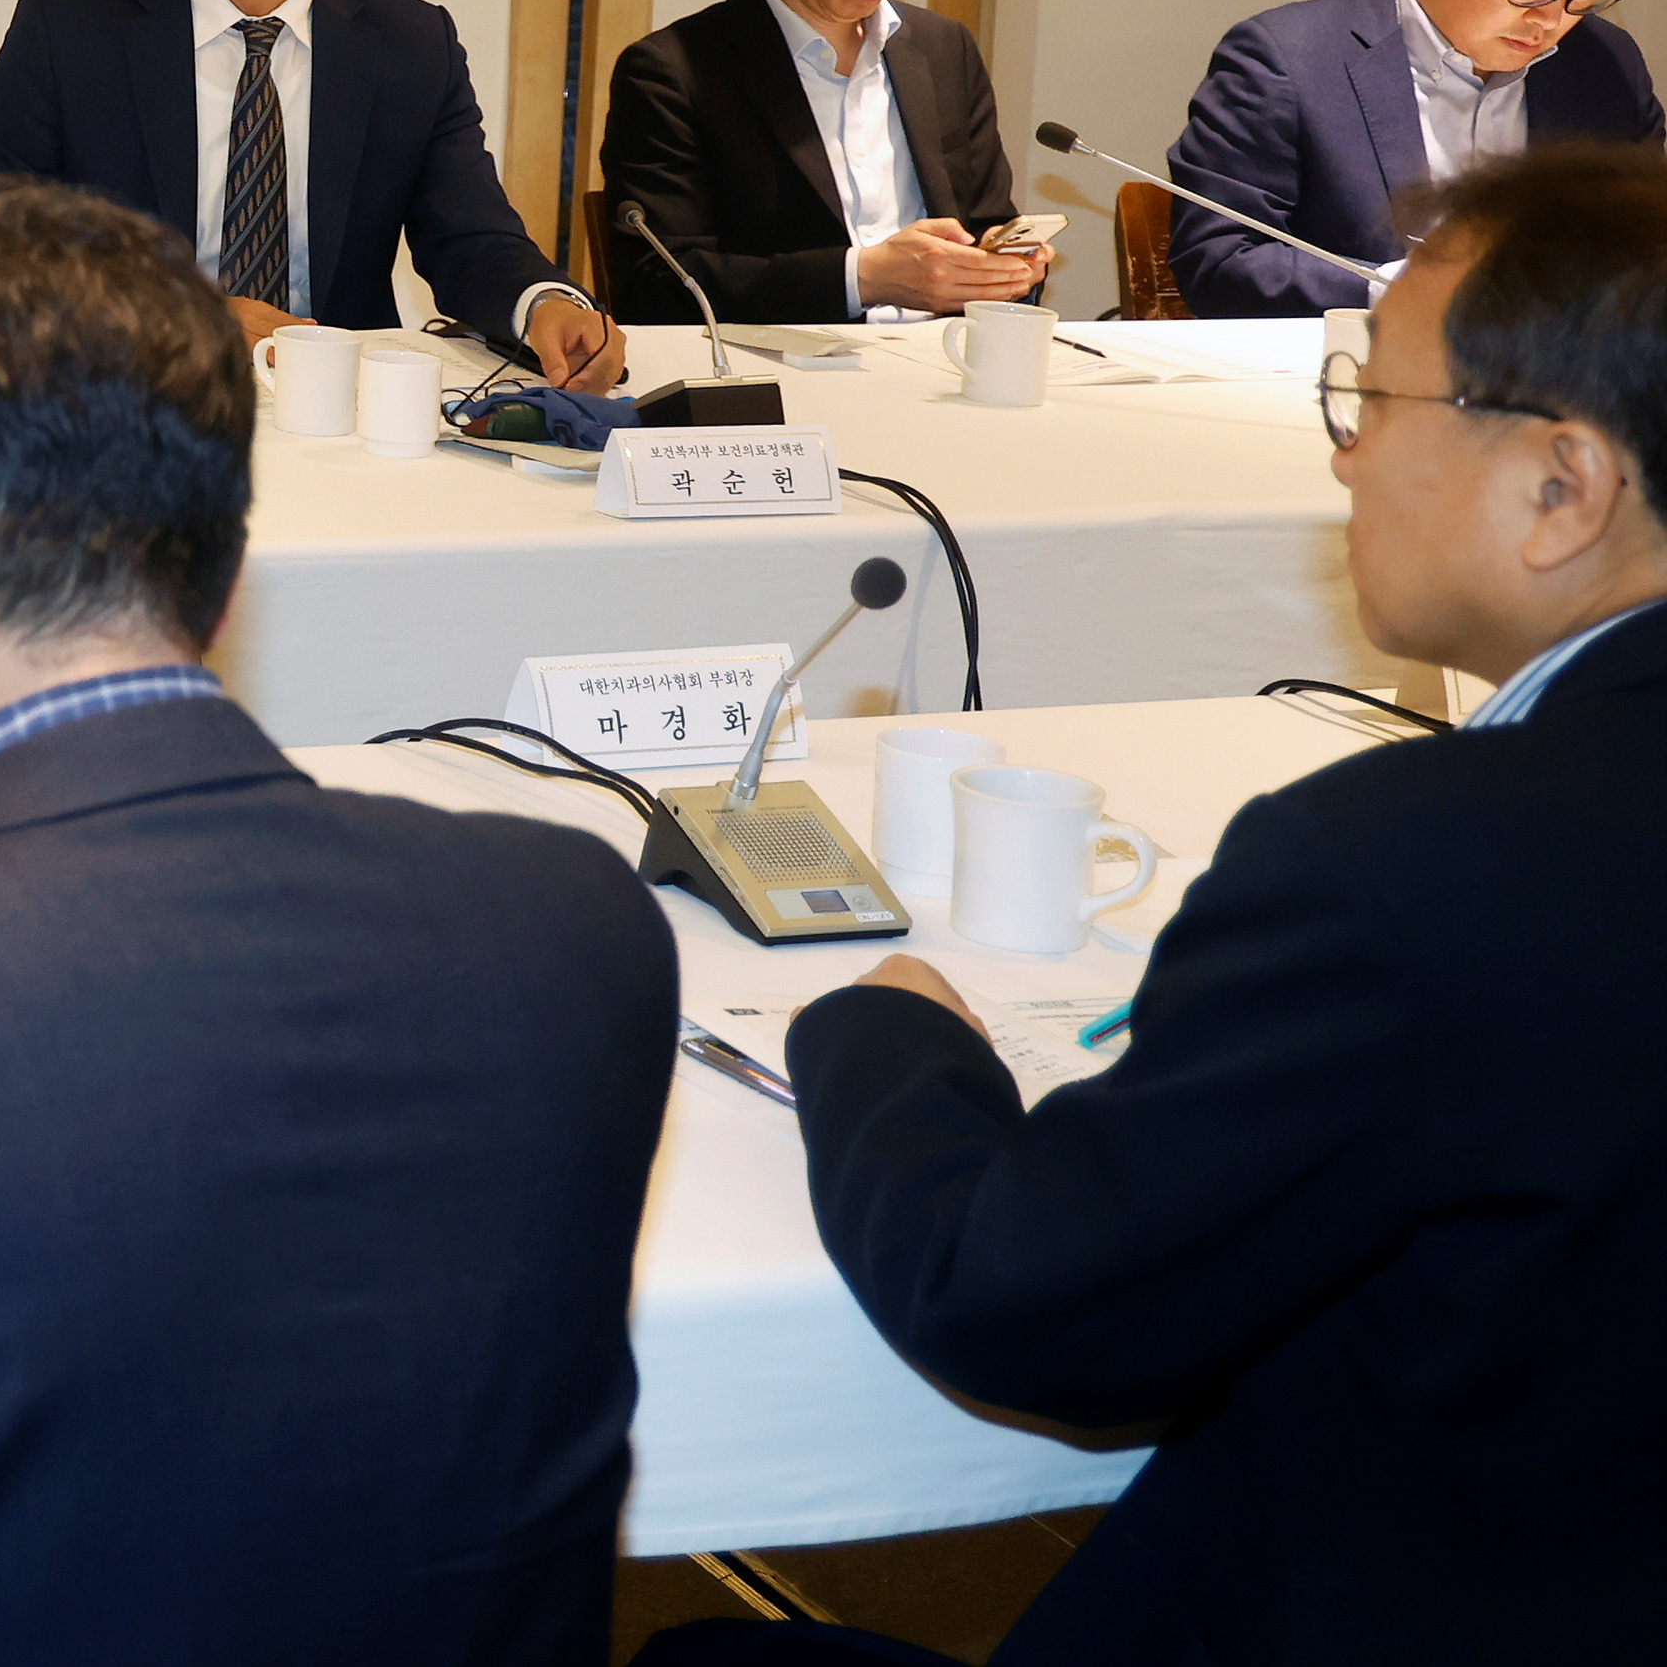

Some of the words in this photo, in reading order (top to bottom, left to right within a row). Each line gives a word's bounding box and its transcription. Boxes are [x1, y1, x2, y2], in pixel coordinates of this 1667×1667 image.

[649, 444, 713, 459] 보건복지부
[718, 442, 805, 458] 보건의료정책관
[578, 669, 703, 697] 대한치과의사협회
[708, 667, 755, 689] 부회장
